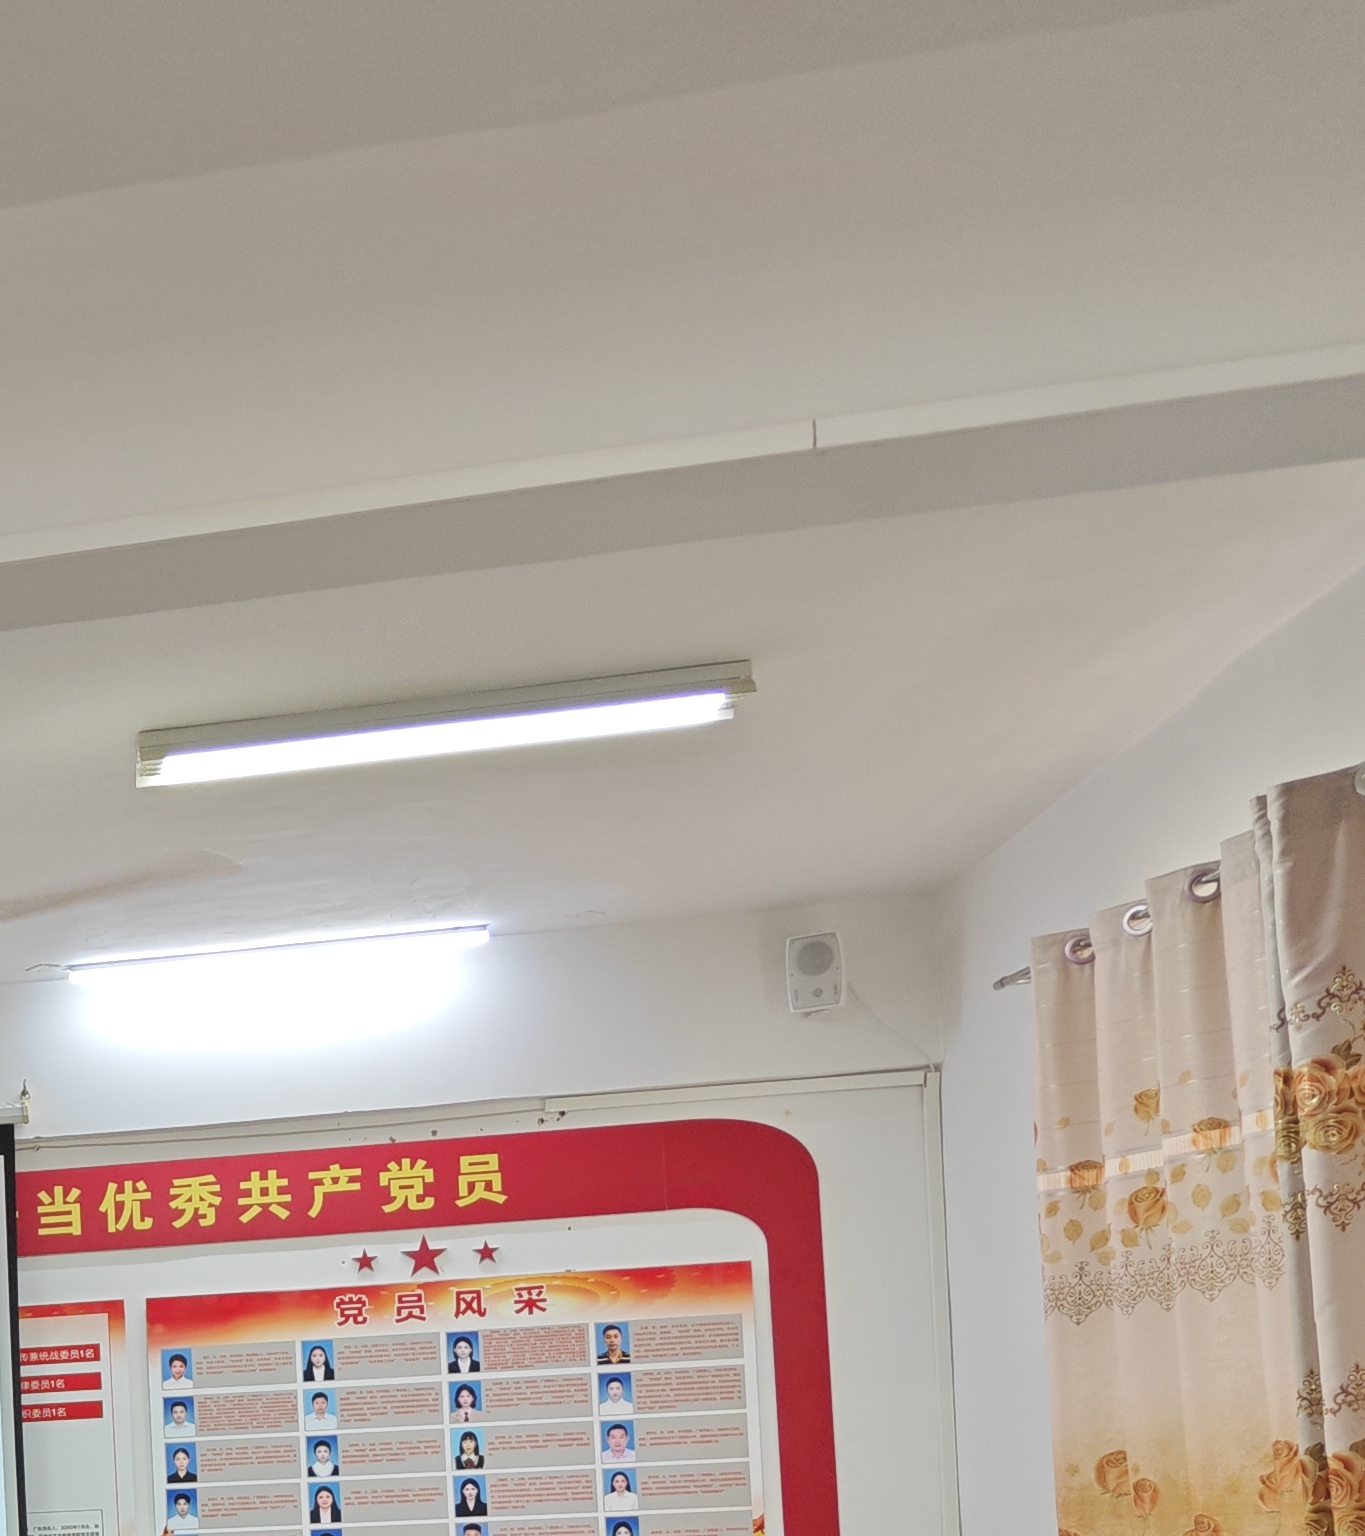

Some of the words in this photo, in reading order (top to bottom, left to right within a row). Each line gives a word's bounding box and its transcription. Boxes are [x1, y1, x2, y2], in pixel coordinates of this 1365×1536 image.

[11, 1153, 509, 1236] 当优秀共产党员
[334, 1285, 549, 1327] 党员风采
